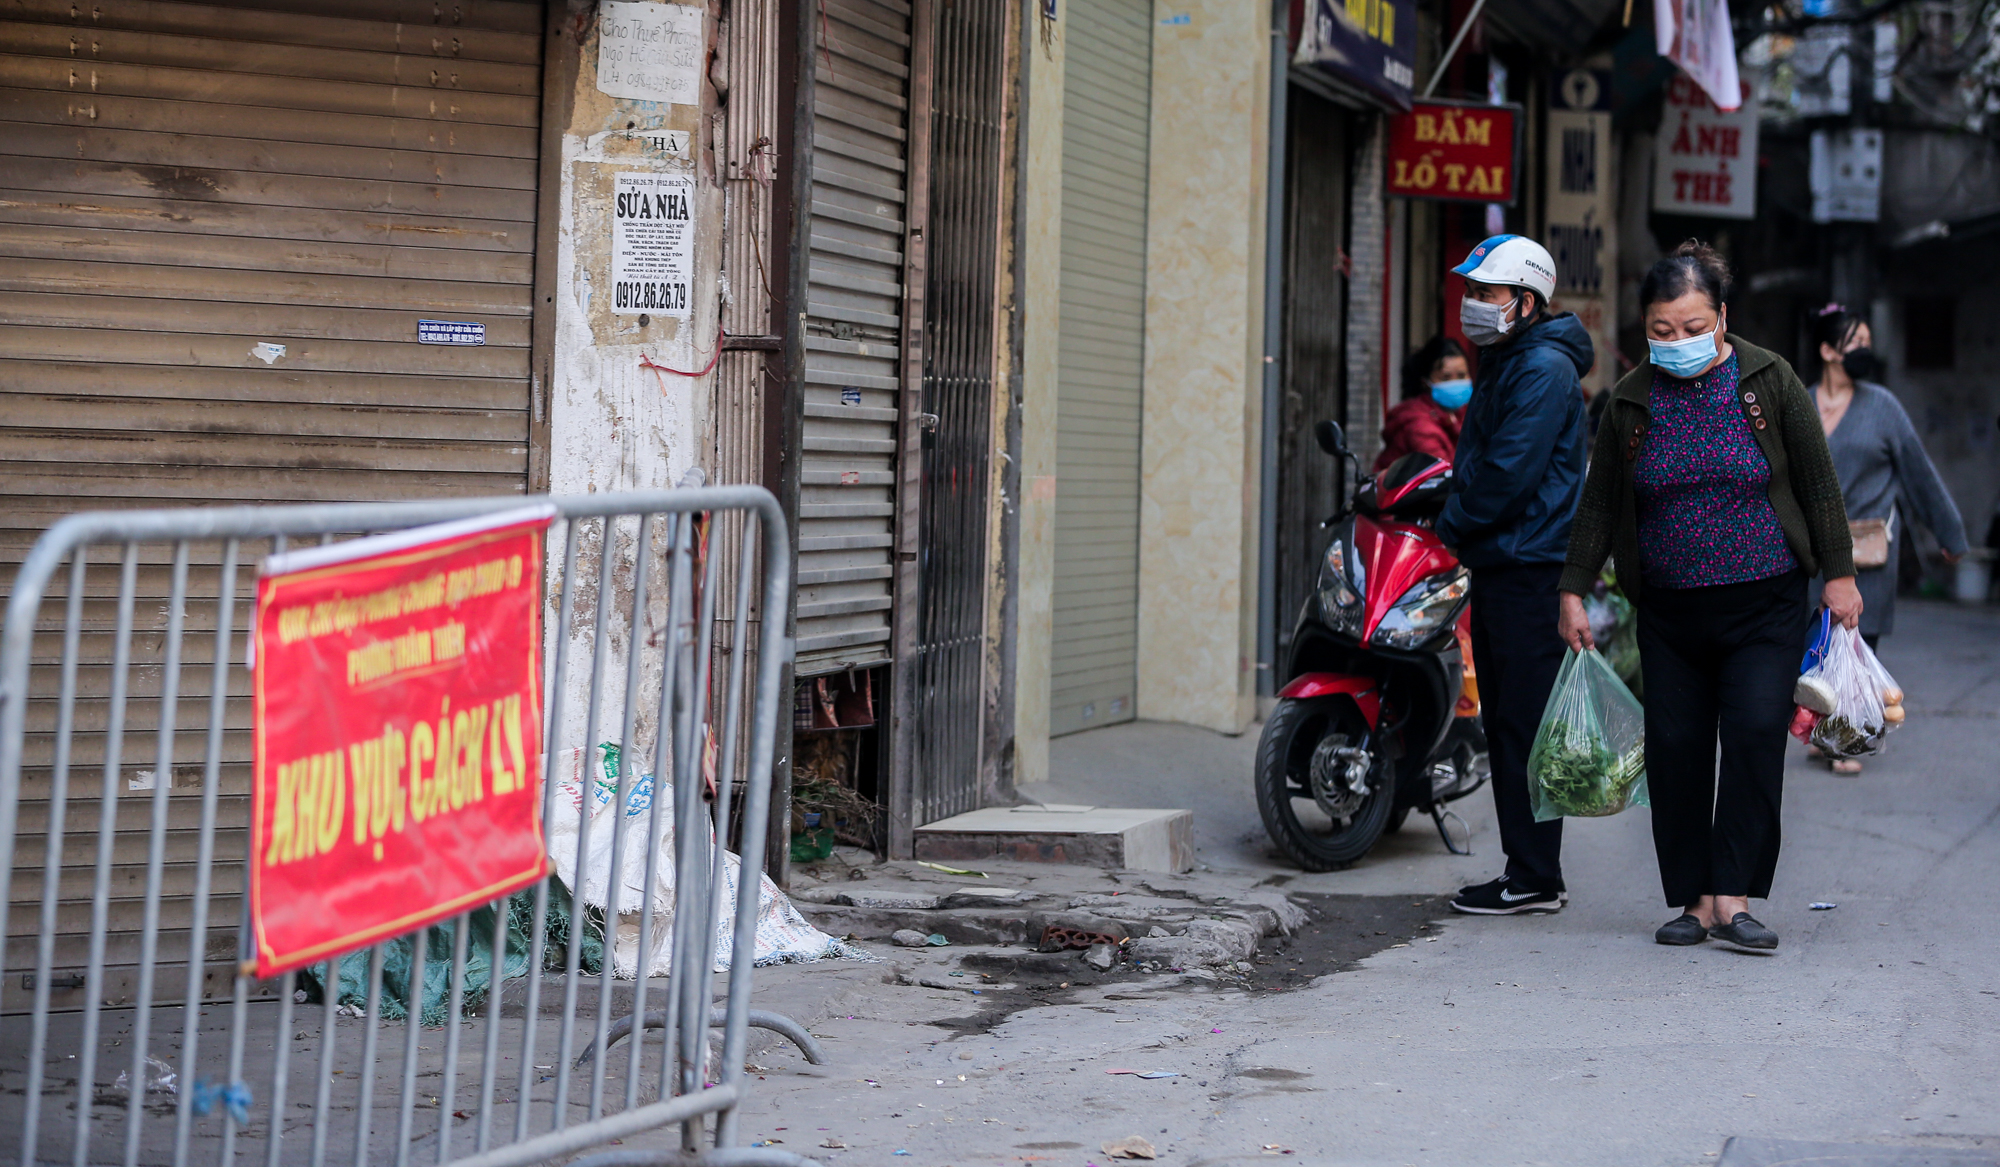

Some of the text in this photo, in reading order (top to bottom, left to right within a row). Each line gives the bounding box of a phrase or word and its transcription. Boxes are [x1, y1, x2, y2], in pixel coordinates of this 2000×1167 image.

[602, 17, 628, 38] Cho
[630, 19, 661, 42] Thuê
[603, 45, 625, 68] Ngõ
[648, 134, 679, 152] HÀ
[1414, 108, 1493, 147] BẤM
[1671, 110, 1742, 158] ẢNH
[1393, 149, 1504, 195] LỖ TAI
[1672, 161, 1734, 206] THẺ
[617, 186, 690, 220] SỬA NHÀ
[616, 281, 686, 310] 0912.86.26.79
[266, 748, 346, 867] KHU
[350, 722, 406, 862] VỰC
[410, 694, 489, 824] CÁCH
